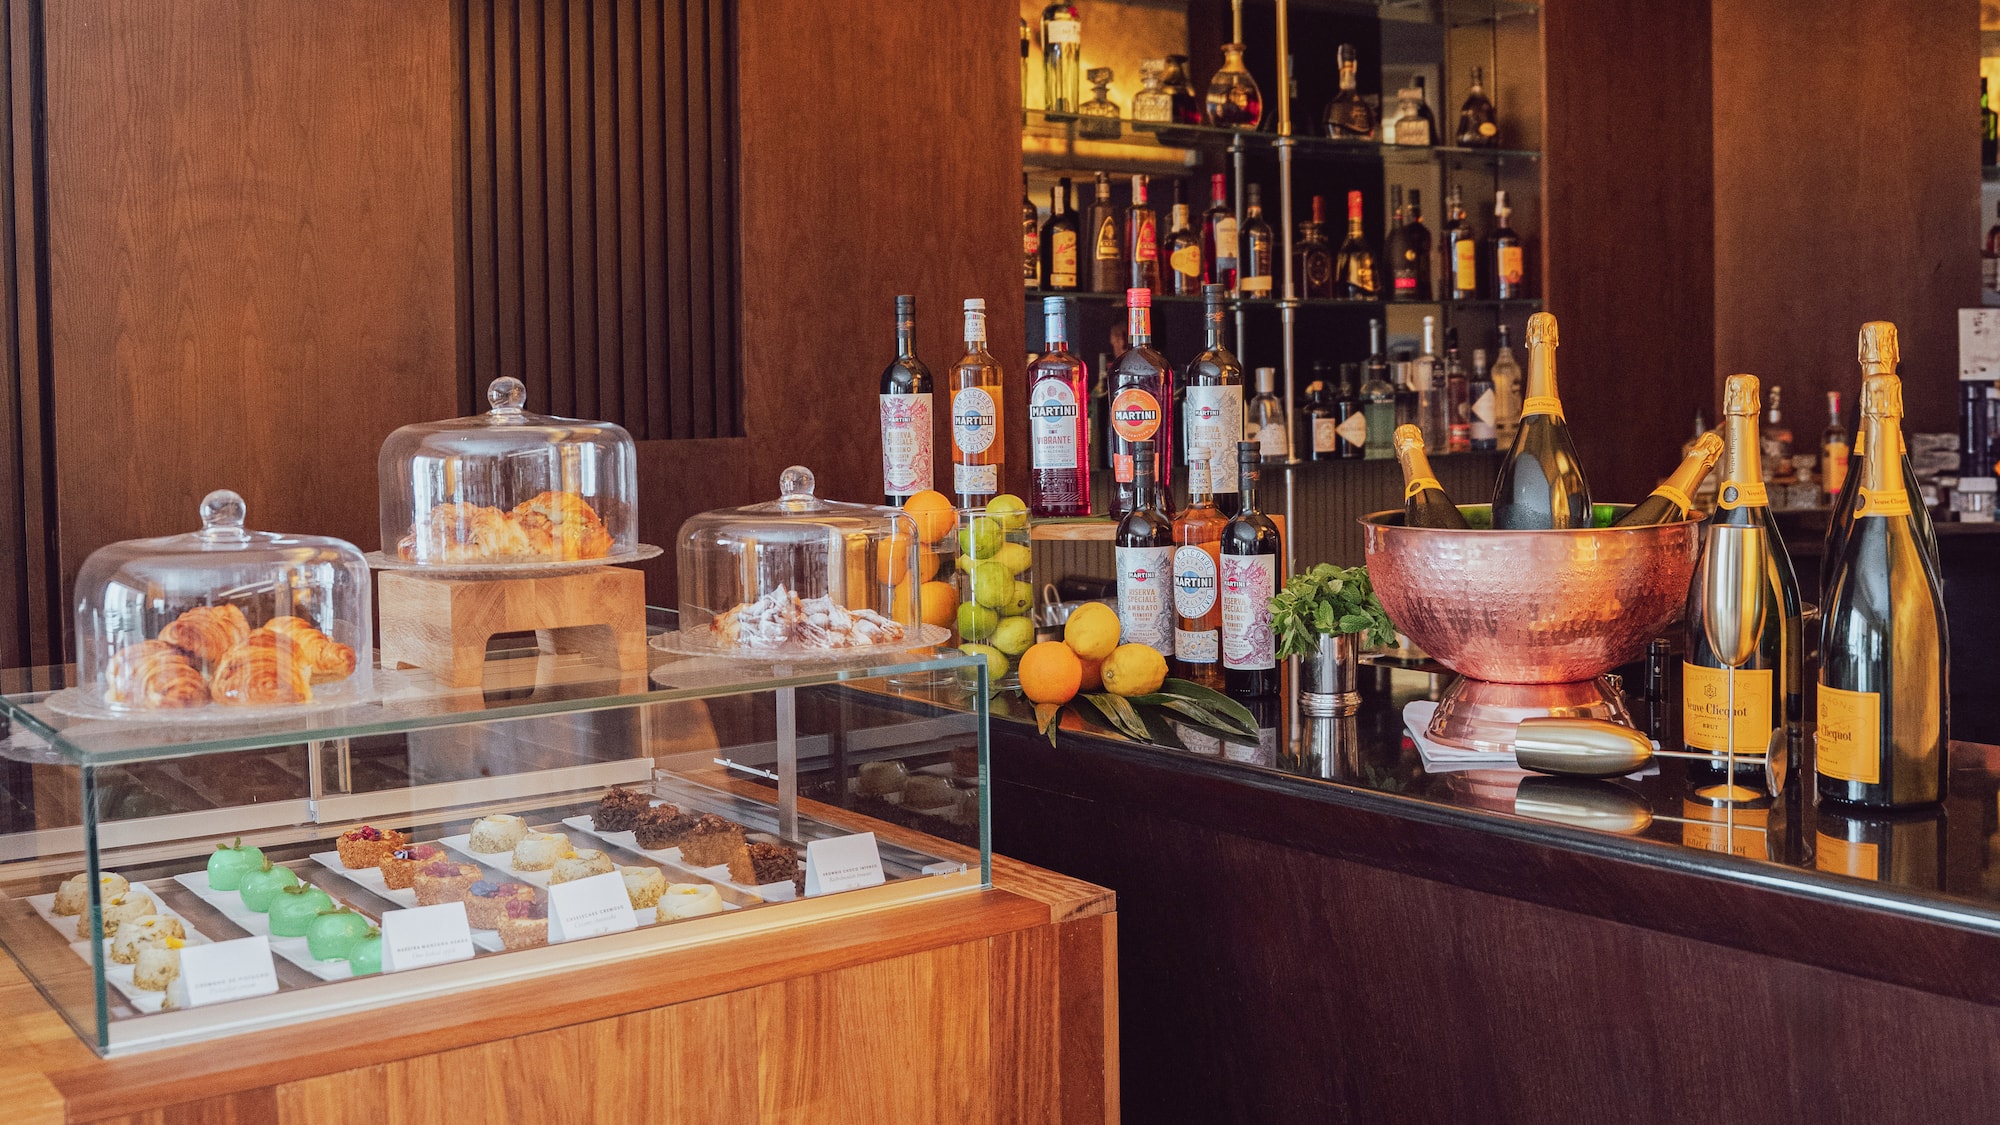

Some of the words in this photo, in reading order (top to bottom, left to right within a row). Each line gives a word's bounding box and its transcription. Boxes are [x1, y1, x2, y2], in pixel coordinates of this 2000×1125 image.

[1032, 405, 1076, 417] MARTINI
[1115, 410, 1156, 421] MARTINI
[955, 416, 992, 425] MARTINI
[1037, 435, 1071, 445] VIBRANTE
[1175, 577, 1213, 588] MARTINI
[1128, 588, 1157, 596] RISERVA
[1224, 597, 1247, 605] RISERVA
[1223, 604, 1248, 613] SPECIALE
[1686, 697, 1704, 713] Veuve
[1820, 724, 1852, 742] Clicquot
